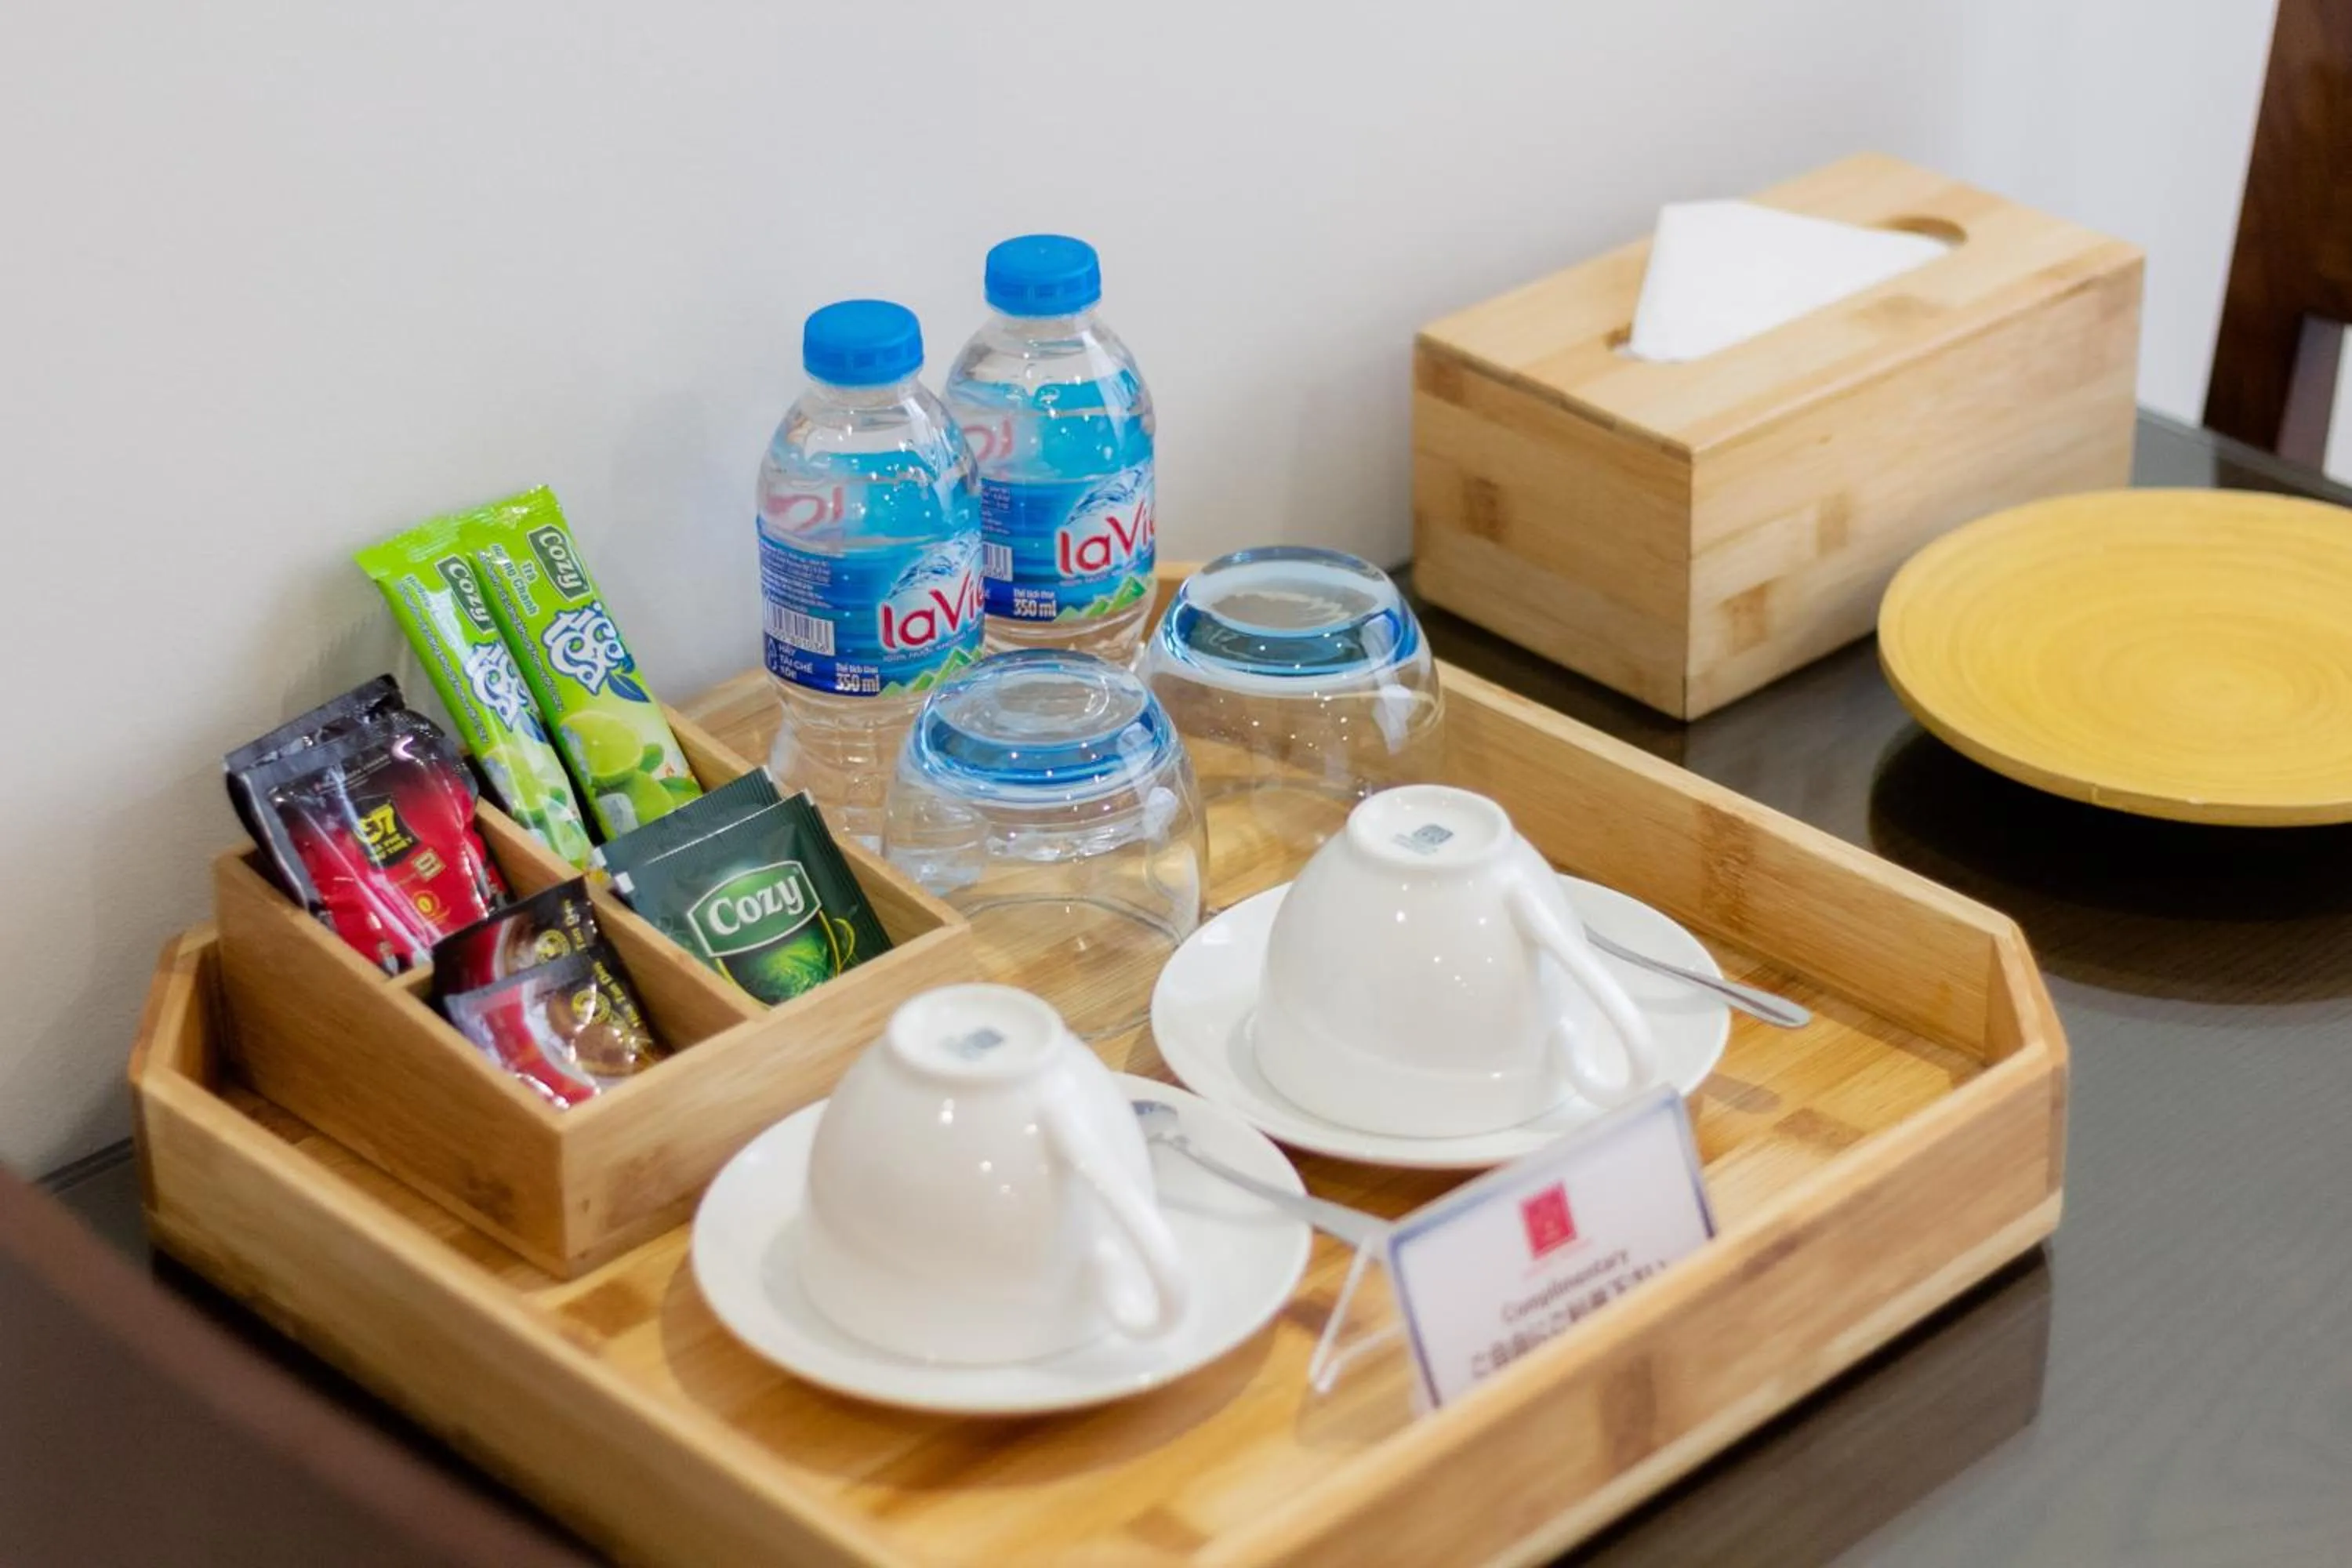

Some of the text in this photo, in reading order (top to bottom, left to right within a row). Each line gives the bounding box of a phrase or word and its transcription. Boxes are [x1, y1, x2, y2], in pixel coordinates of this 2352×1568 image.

[539, 530, 583, 590] Cozy
[448, 562, 492, 622] Cozy
[1013, 598, 1057, 618] 350 ml
[834, 673, 880, 691] 350 ml
[708, 876, 805, 935] Cozy
[1501, 1248, 1628, 1323] Complimentary
